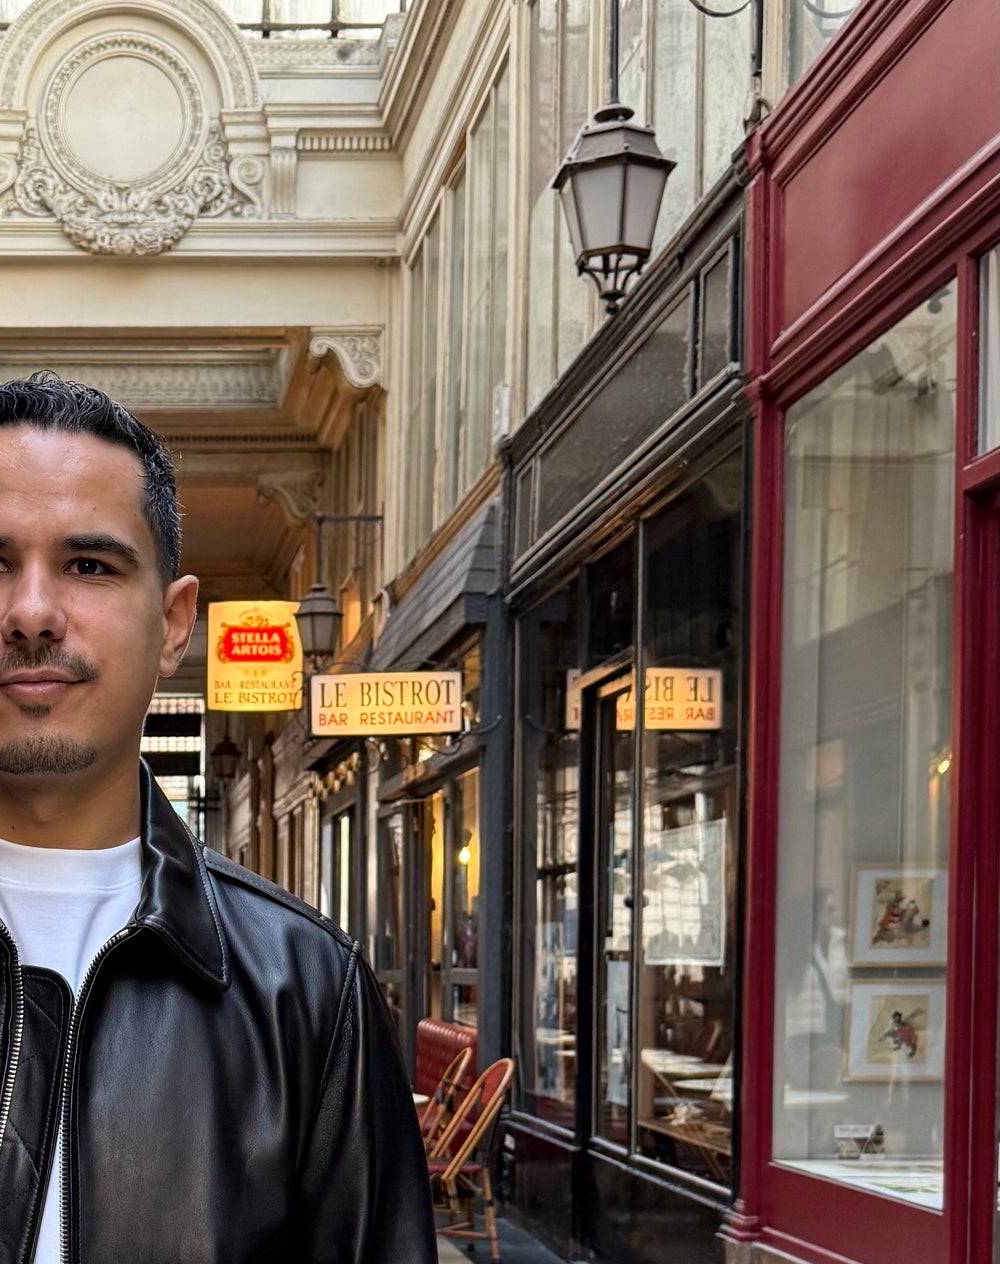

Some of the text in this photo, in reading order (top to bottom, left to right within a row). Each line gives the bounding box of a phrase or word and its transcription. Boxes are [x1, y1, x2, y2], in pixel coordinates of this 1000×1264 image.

[231, 631, 281, 643] STELLA
[231, 644, 282, 656] ARTOIS
[214, 680, 231, 690] BAR
[214, 691, 296, 704] LE BISTROT
[319, 679, 456, 708] LE BISTROT
[318, 710, 456, 727] BAR RESTAURANT
